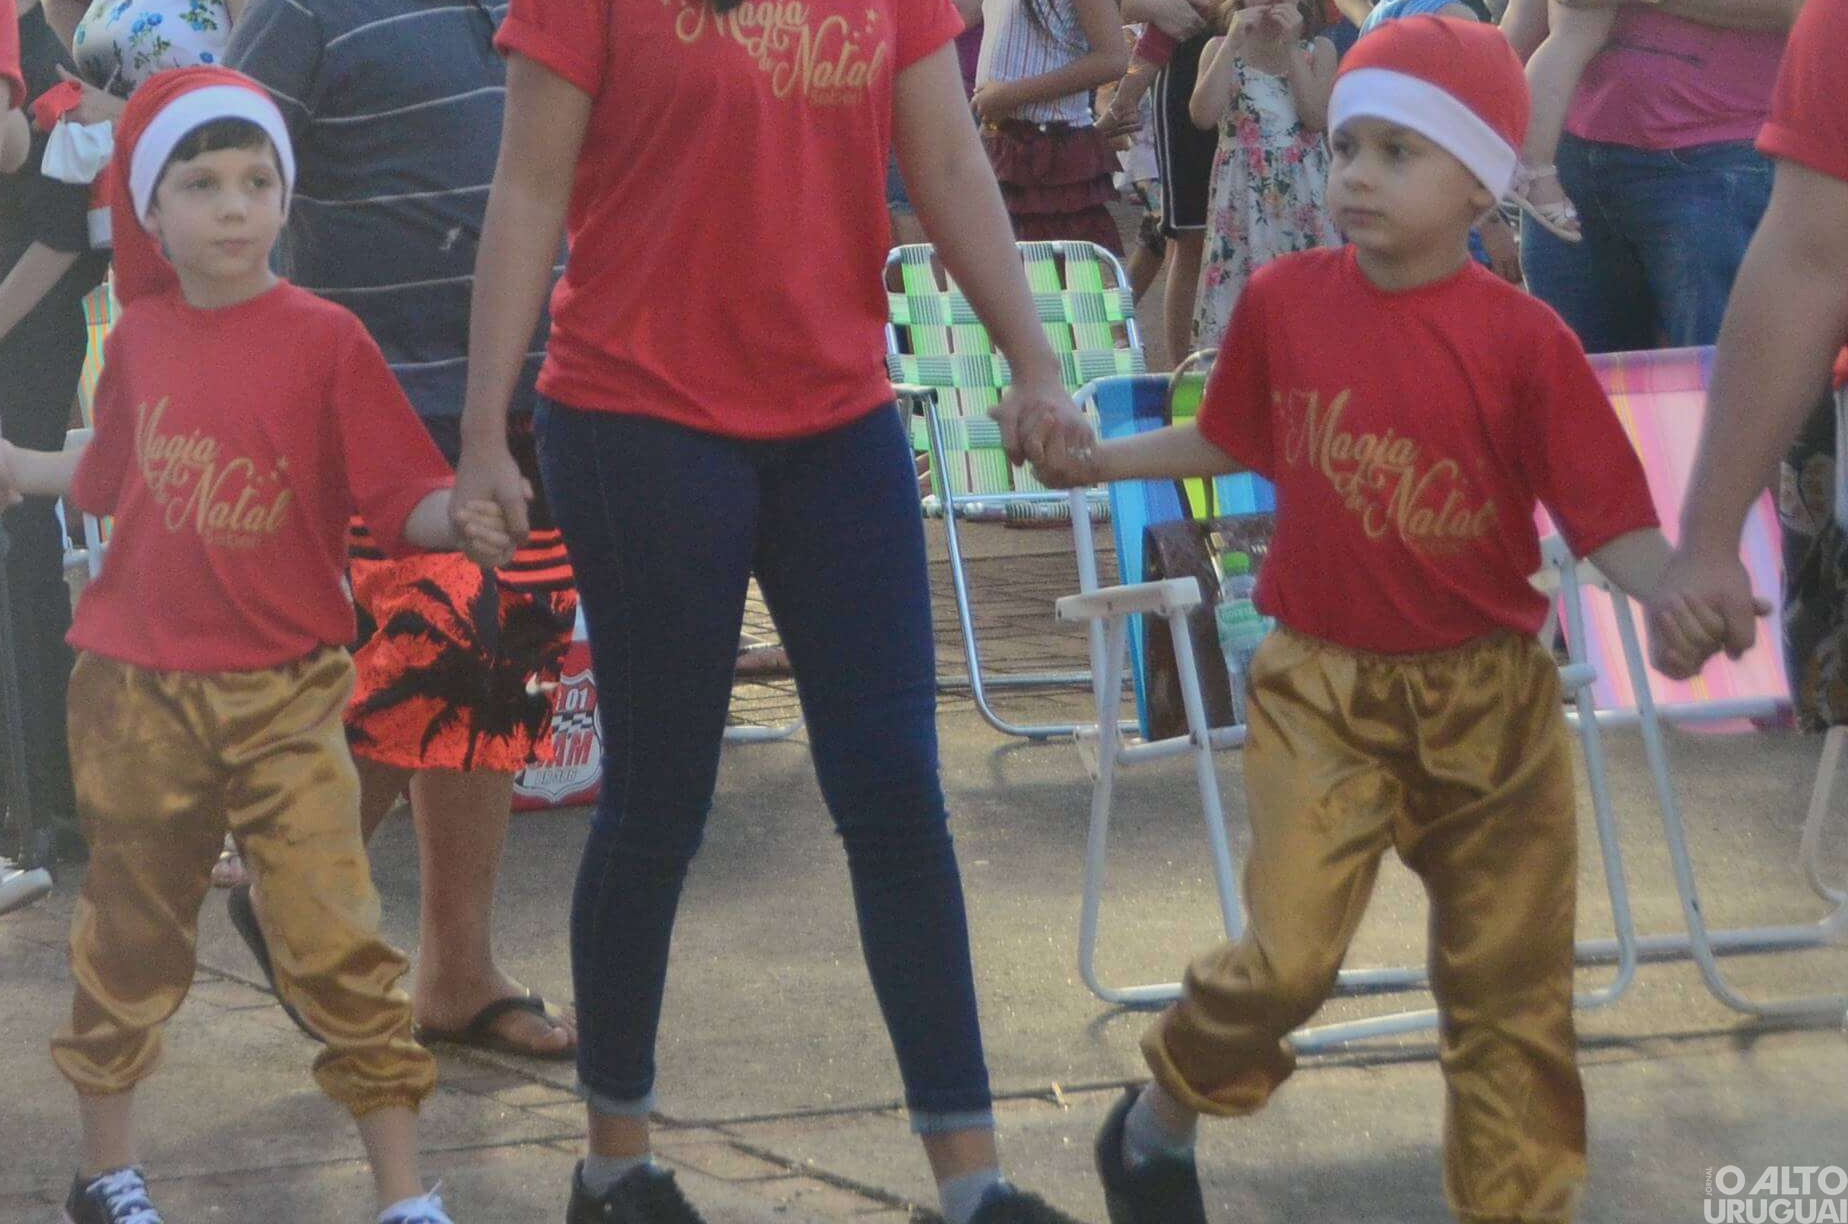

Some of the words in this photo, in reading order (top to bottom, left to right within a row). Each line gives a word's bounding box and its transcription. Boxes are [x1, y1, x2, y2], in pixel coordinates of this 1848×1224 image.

[772, 15, 887, 99] Natal
[1285, 388, 1418, 494] Magia
[165, 456, 294, 534] Natal
[1362, 458, 1498, 539] Natal
